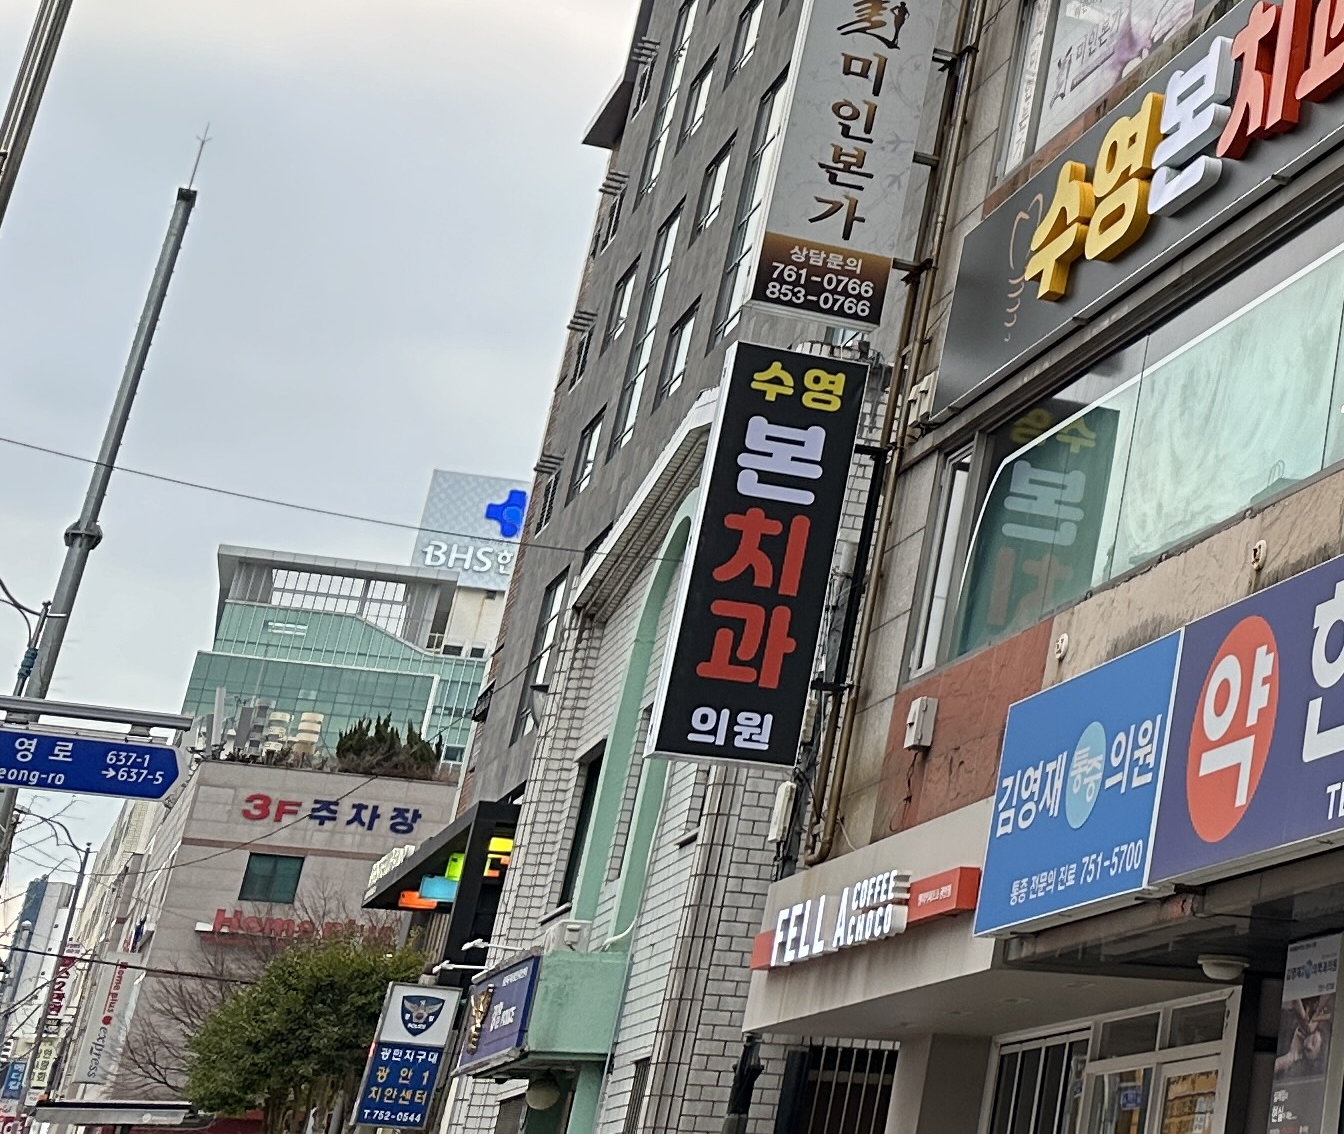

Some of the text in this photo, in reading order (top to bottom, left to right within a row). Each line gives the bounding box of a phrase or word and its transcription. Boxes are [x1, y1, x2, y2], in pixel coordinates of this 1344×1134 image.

[807, 52, 888, 241] 미인본가
[770, 262, 875, 298] 761-0766
[789, 244, 863, 275] 상담문의
[765, 281, 871, 317] 853-0766
[750, 360, 847, 413] 수영
[687, 706, 774, 752] 의원
[1200, 644, 1274, 808] 약
[106, 750, 151, 768] 637-1
[117, 768, 165, 785] 637-5
[996, 750, 1067, 838] 김영재
[1104, 713, 1162, 794] 의원
[240, 793, 422, 835] 3F 주차장
[1080, 839, 1144, 886] 751-5700
[212, 908, 315, 937] Home
[770, 894, 826, 967] FELL
[851, 869, 898, 911] COFFEE
[848, 903, 894, 946] CHOCO
[368, 1086, 428, 1106] 치안센터
